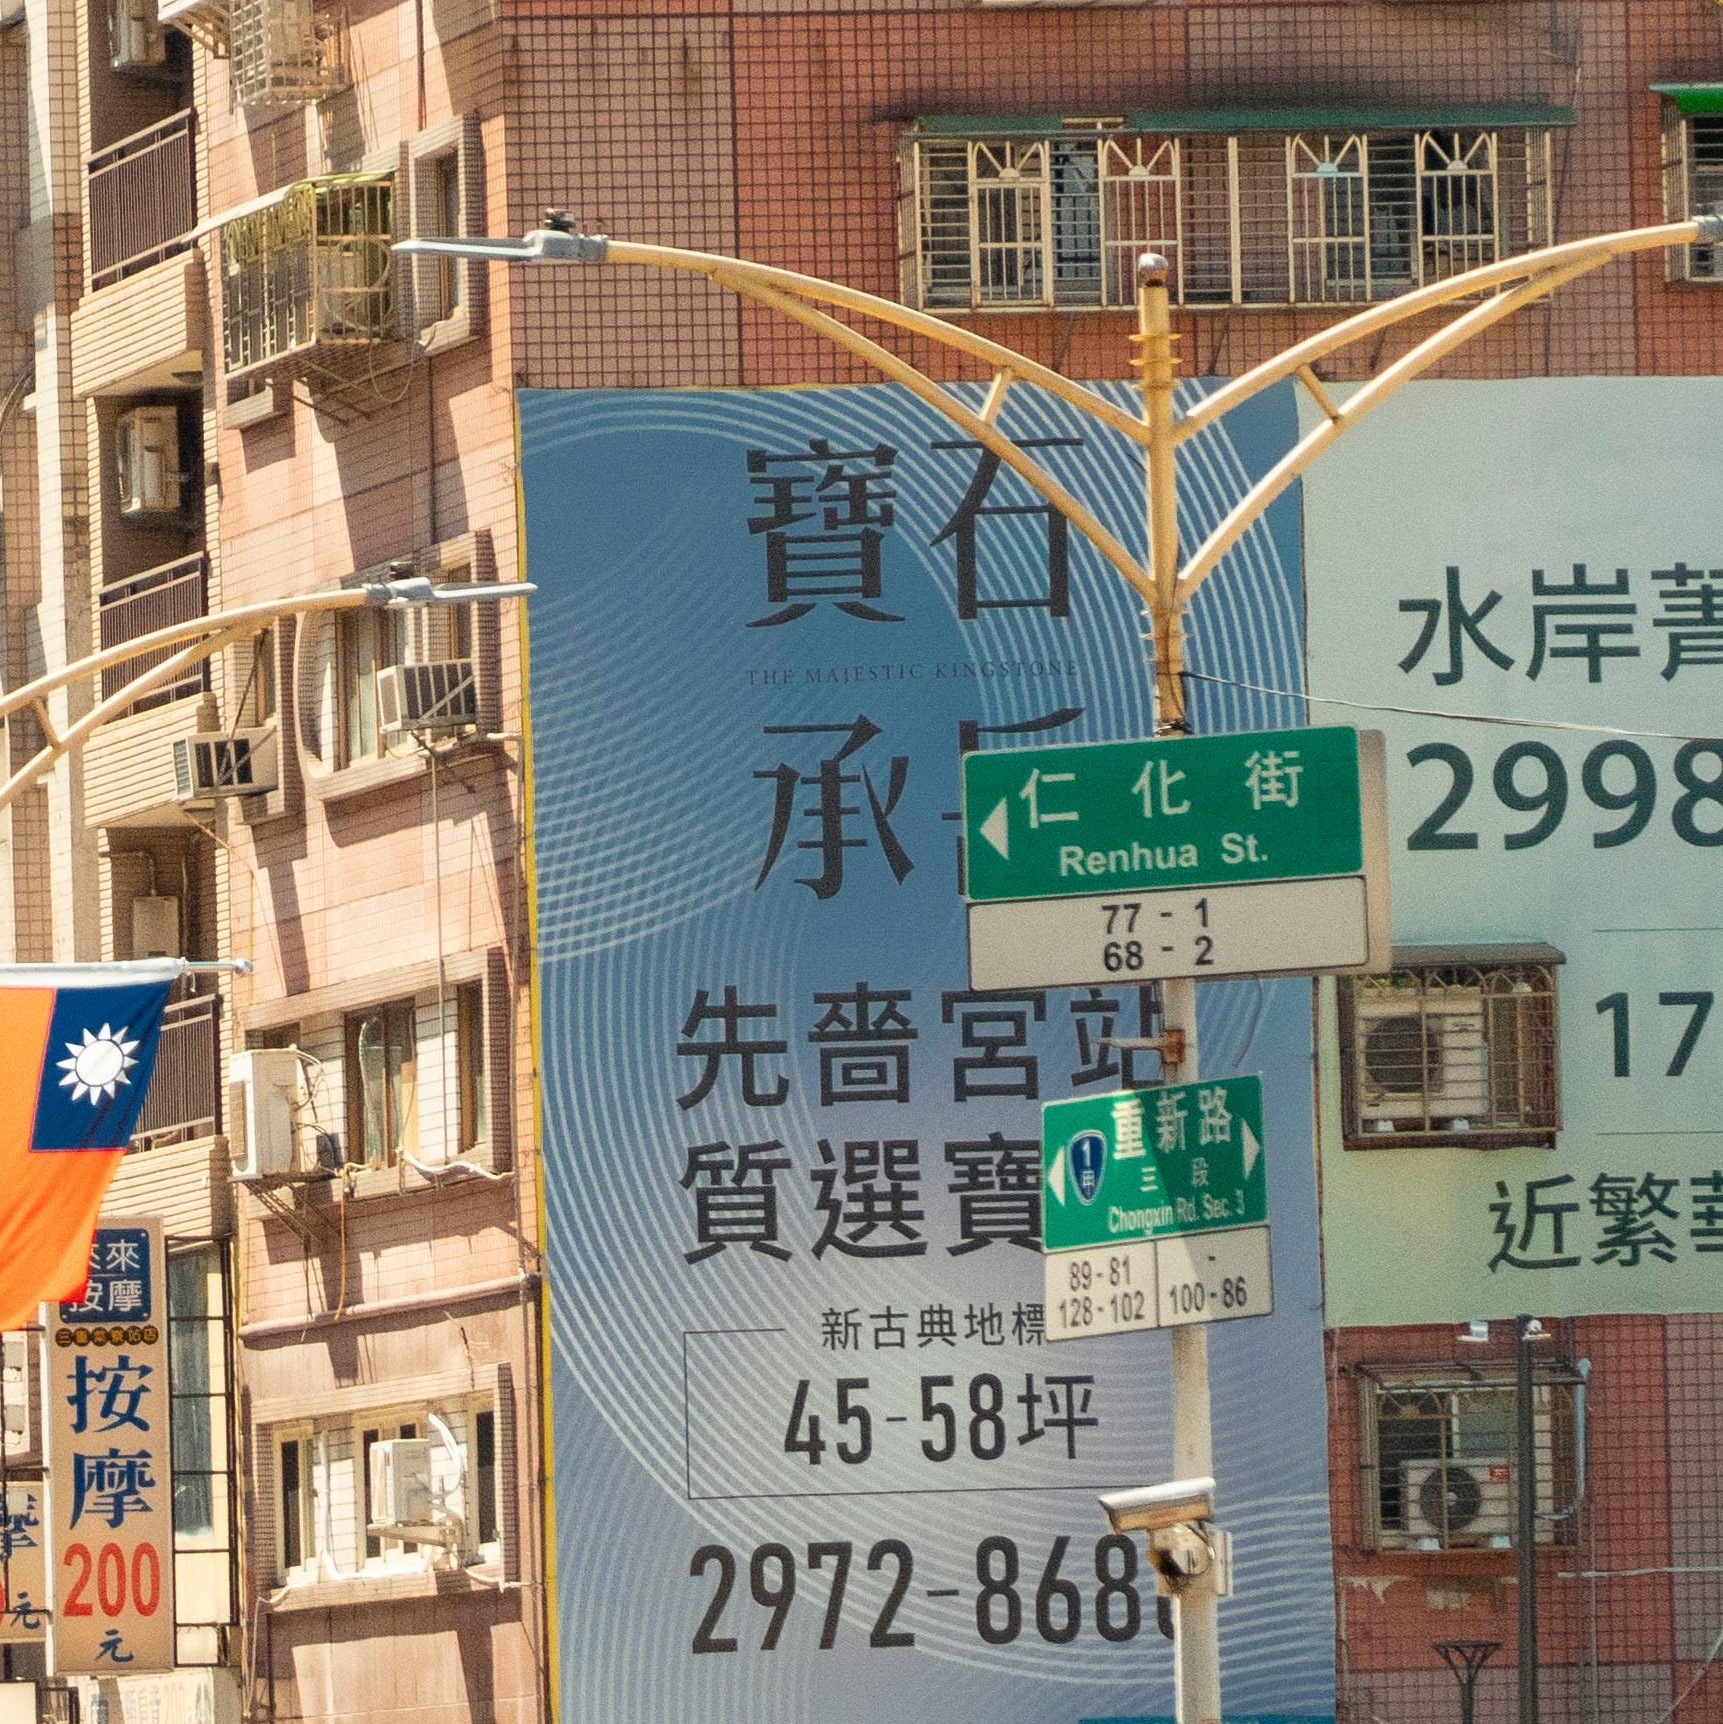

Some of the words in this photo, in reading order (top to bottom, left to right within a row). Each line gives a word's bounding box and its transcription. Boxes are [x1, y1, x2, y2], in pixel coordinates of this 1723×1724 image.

[745, 437, 1084, 628] 寶石
[746, 669, 794, 685] THE
[804, 663, 924, 685] MAJESTIC
[934, 659, 1079, 681] KINGSTONE
[1019, 750, 1304, 830] 仁化街
[1059, 840, 1198, 877] Renhua
[1221, 832, 1269, 866] St.
[1102, 903, 1143, 935] 77
[1194, 897, 1210, 929] 1
[1103, 940, 1144, 973] 68
[1193, 934, 1215, 967] 2
[1111, 1085, 1233, 1161] 重新路
[1108, 1203, 1175, 1237] Chongxin
[821, 1302, 1045, 1352] 新古典地標
[66, 1354, 156, 1531] 按摩
[63, 1541, 161, 1618] 200
[95, 1629, 135, 1663] 元
